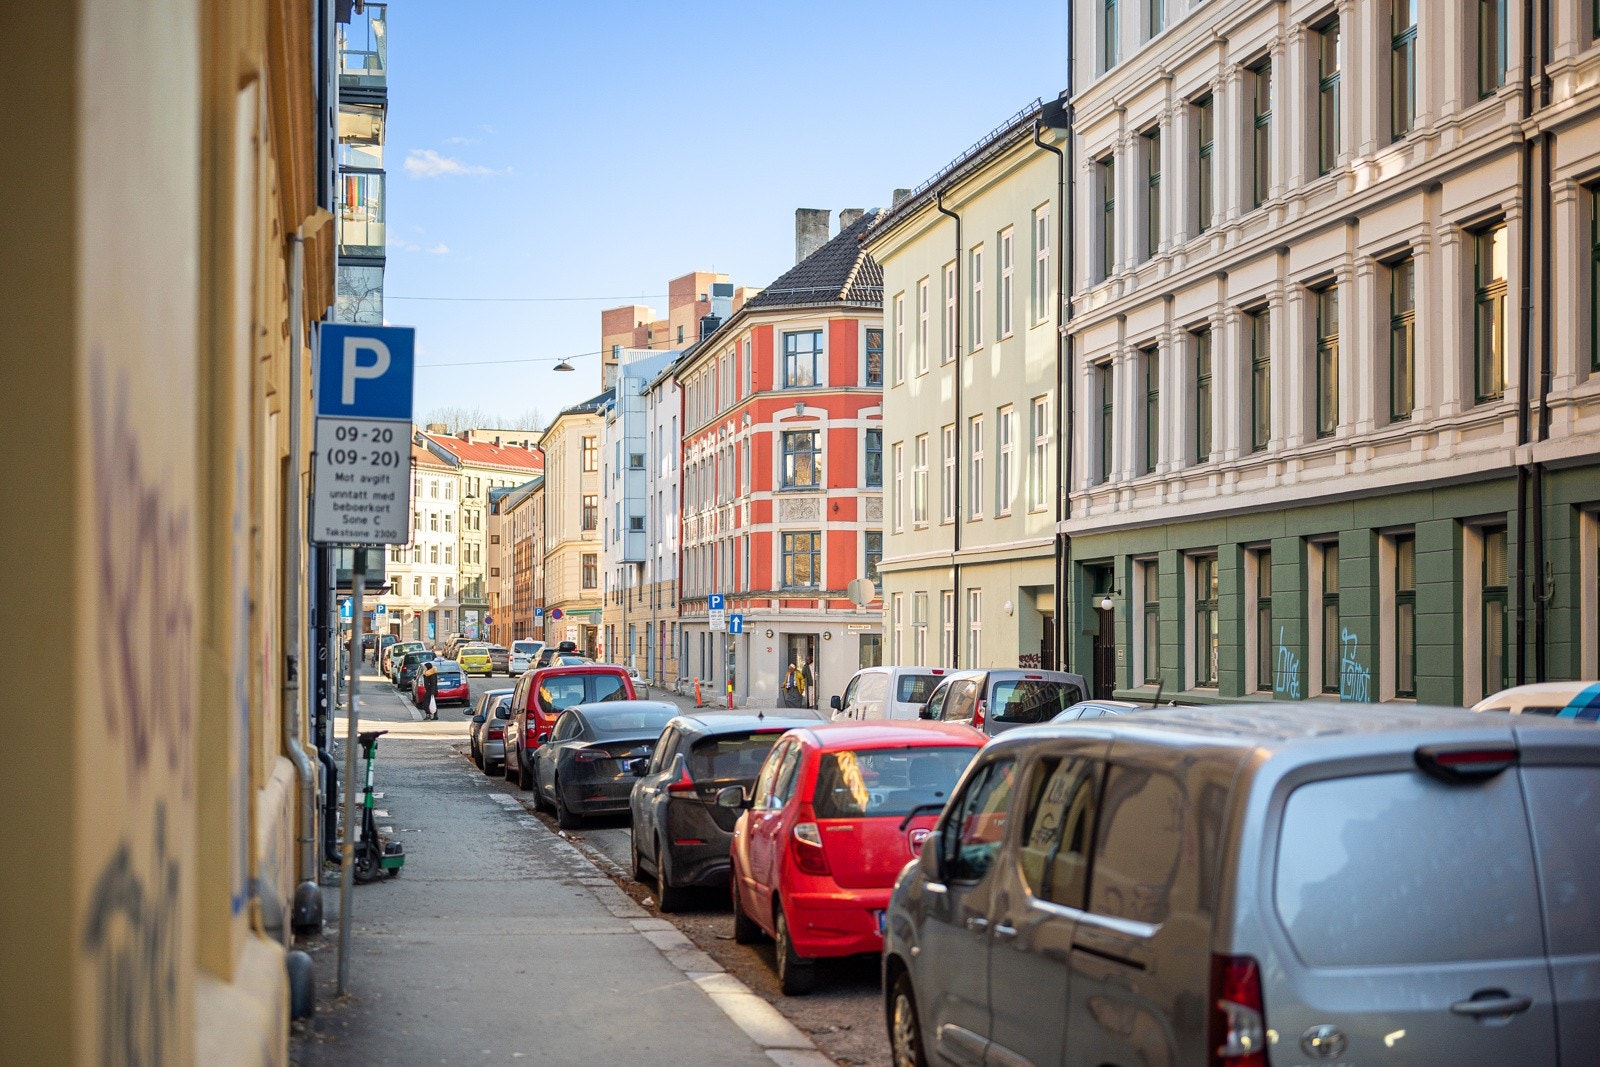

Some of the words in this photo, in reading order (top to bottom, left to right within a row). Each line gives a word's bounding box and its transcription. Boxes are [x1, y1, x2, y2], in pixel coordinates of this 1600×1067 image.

[341, 336, 391, 405] P
[335, 472, 354, 482] Mot
[360, 474, 390, 485] avgift
[329, 490, 367, 500] unntatt
[372, 491, 395, 501] med
[332, 502, 390, 513] beboerkort
[342, 514, 368, 525] Sone
[373, 515, 381, 526] C
[711, 595, 721, 608] P
[536, 608, 542, 616] P
